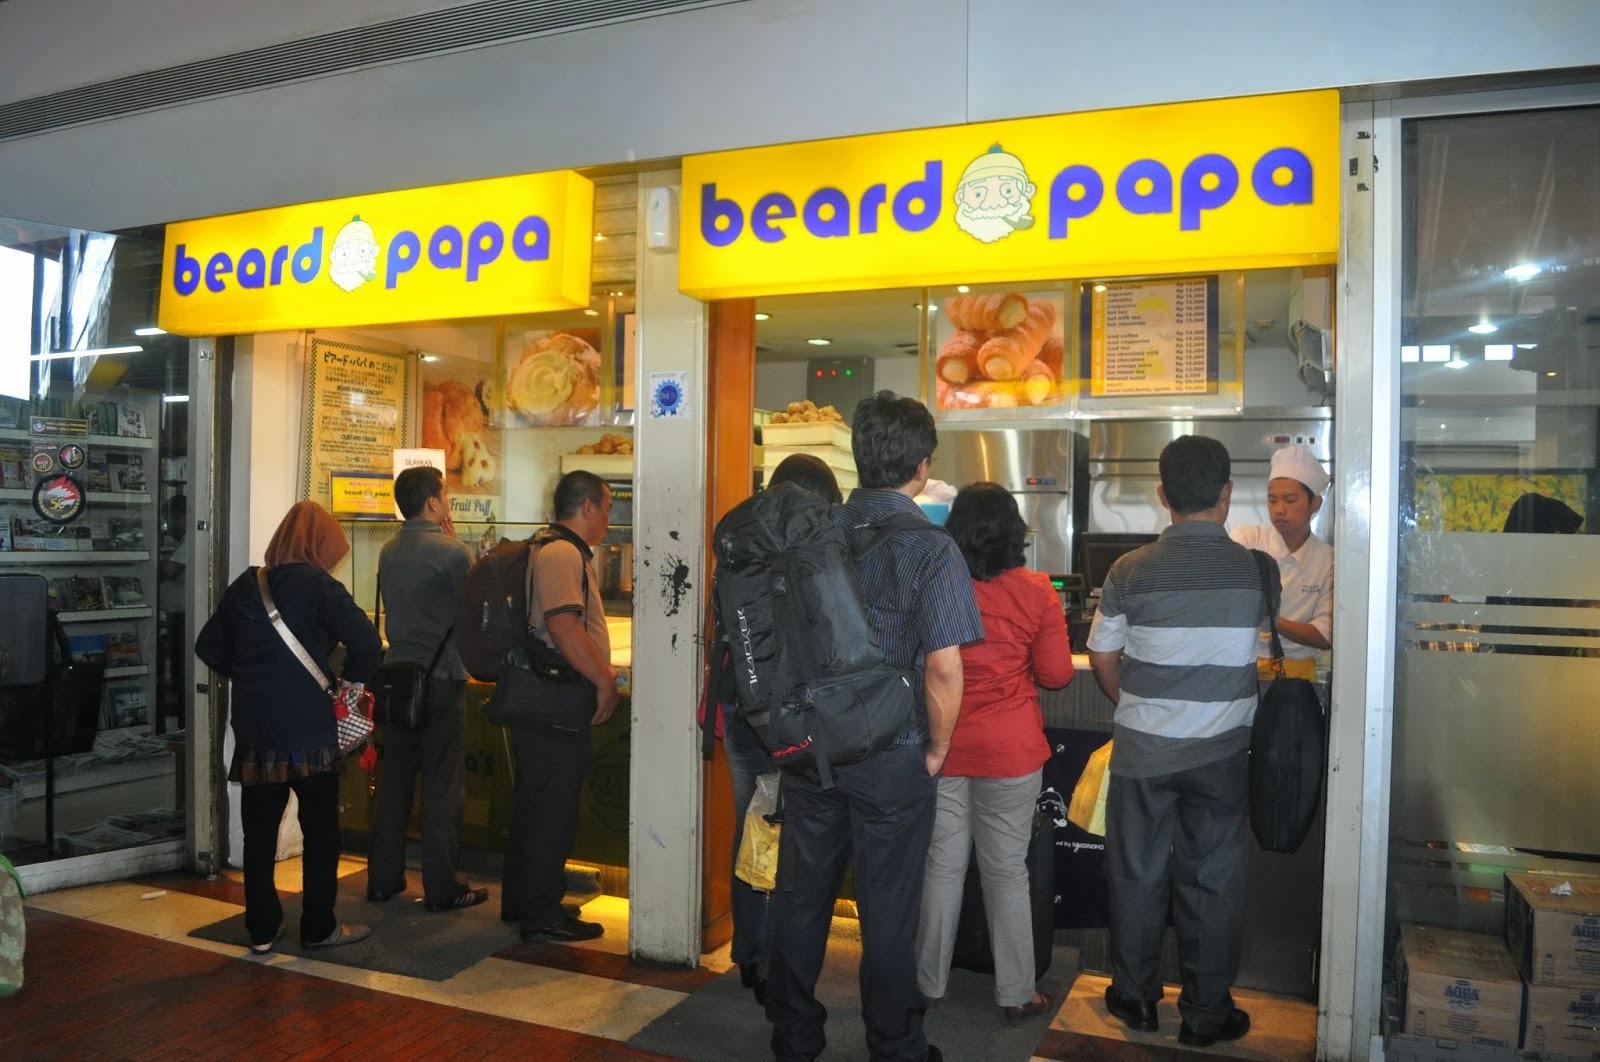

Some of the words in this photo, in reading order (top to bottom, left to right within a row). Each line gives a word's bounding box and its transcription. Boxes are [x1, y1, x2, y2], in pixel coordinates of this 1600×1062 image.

[702, 161, 943, 247] beard
[1049, 147, 1313, 239] papa
[174, 227, 323, 296] beard
[386, 215, 550, 289] papa
[450, 497, 471, 511] Fruit
[473, 498, 492, 516] Puff
[1444, 985, 1480, 1001] AQUA
